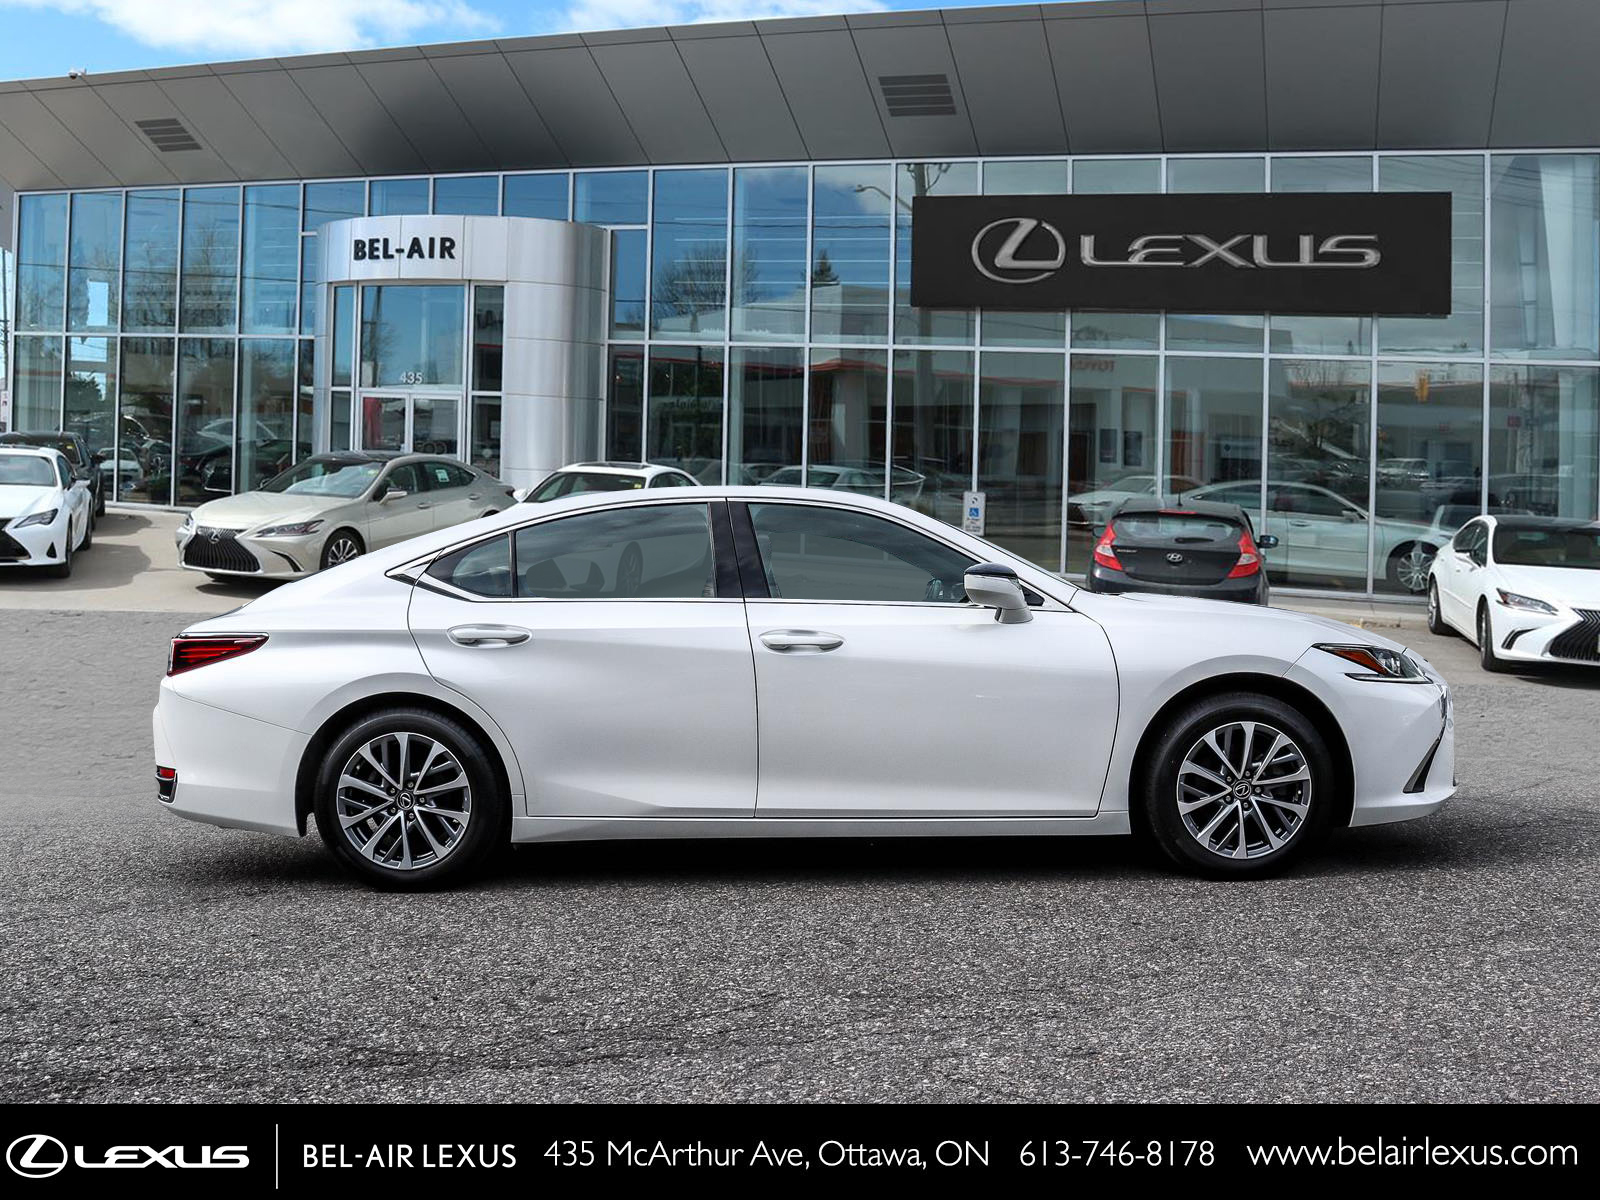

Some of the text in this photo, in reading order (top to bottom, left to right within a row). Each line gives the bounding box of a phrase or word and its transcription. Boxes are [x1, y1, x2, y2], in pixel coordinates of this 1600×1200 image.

[353, 236, 456, 260] BEL-AIR
[1079, 234, 1381, 269] LEXUS
[399, 371, 423, 385] 435
